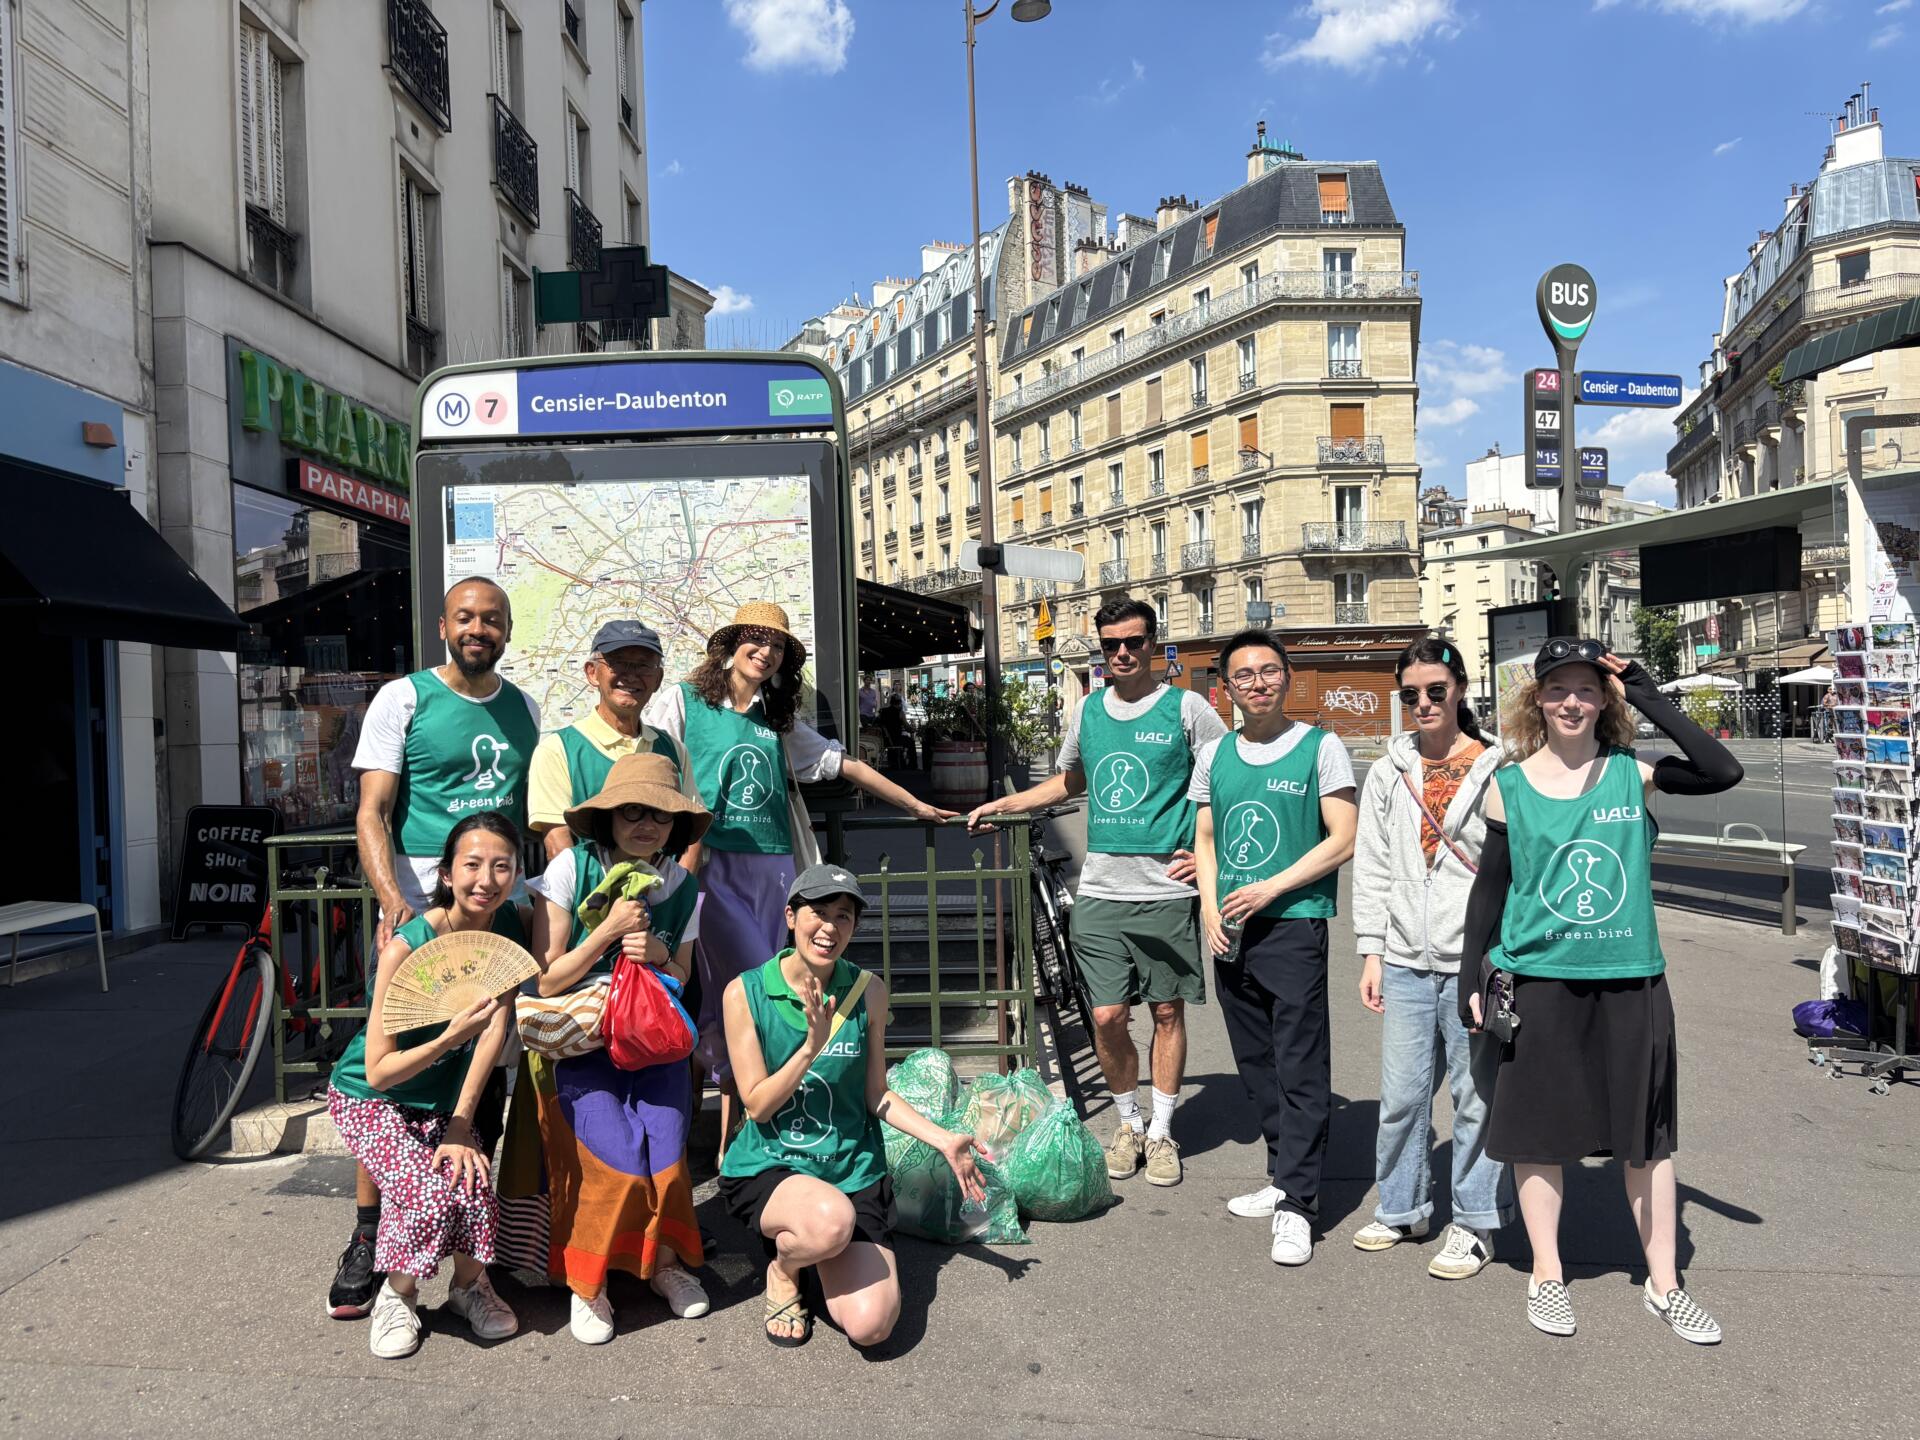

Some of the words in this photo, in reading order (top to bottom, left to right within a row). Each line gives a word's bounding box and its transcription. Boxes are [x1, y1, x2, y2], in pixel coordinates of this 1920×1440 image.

[1551, 282, 1589, 306] BUS
[1538, 373, 1557, 389] 24
[1583, 380, 1618, 394] Censier
[1628, 382, 1678, 397] Daubenton
[443, 400, 464, 418] M
[484, 399, 499, 418] 7
[1538, 412, 1557, 427] 47
[754, 727, 778, 739] UAC
[1135, 731, 1172, 744] UACJ
[1266, 778, 1308, 796] UACJ
[447, 797, 493, 813] green
[1120, 815, 1145, 825] bird
[1593, 805, 1643, 822] UACJ
[197, 826, 262, 843] COFFEE
[1245, 874, 1265, 884] bir
[189, 882, 257, 903] NOIR
[1545, 928, 1594, 940] green
[1598, 928, 1633, 938] bird
